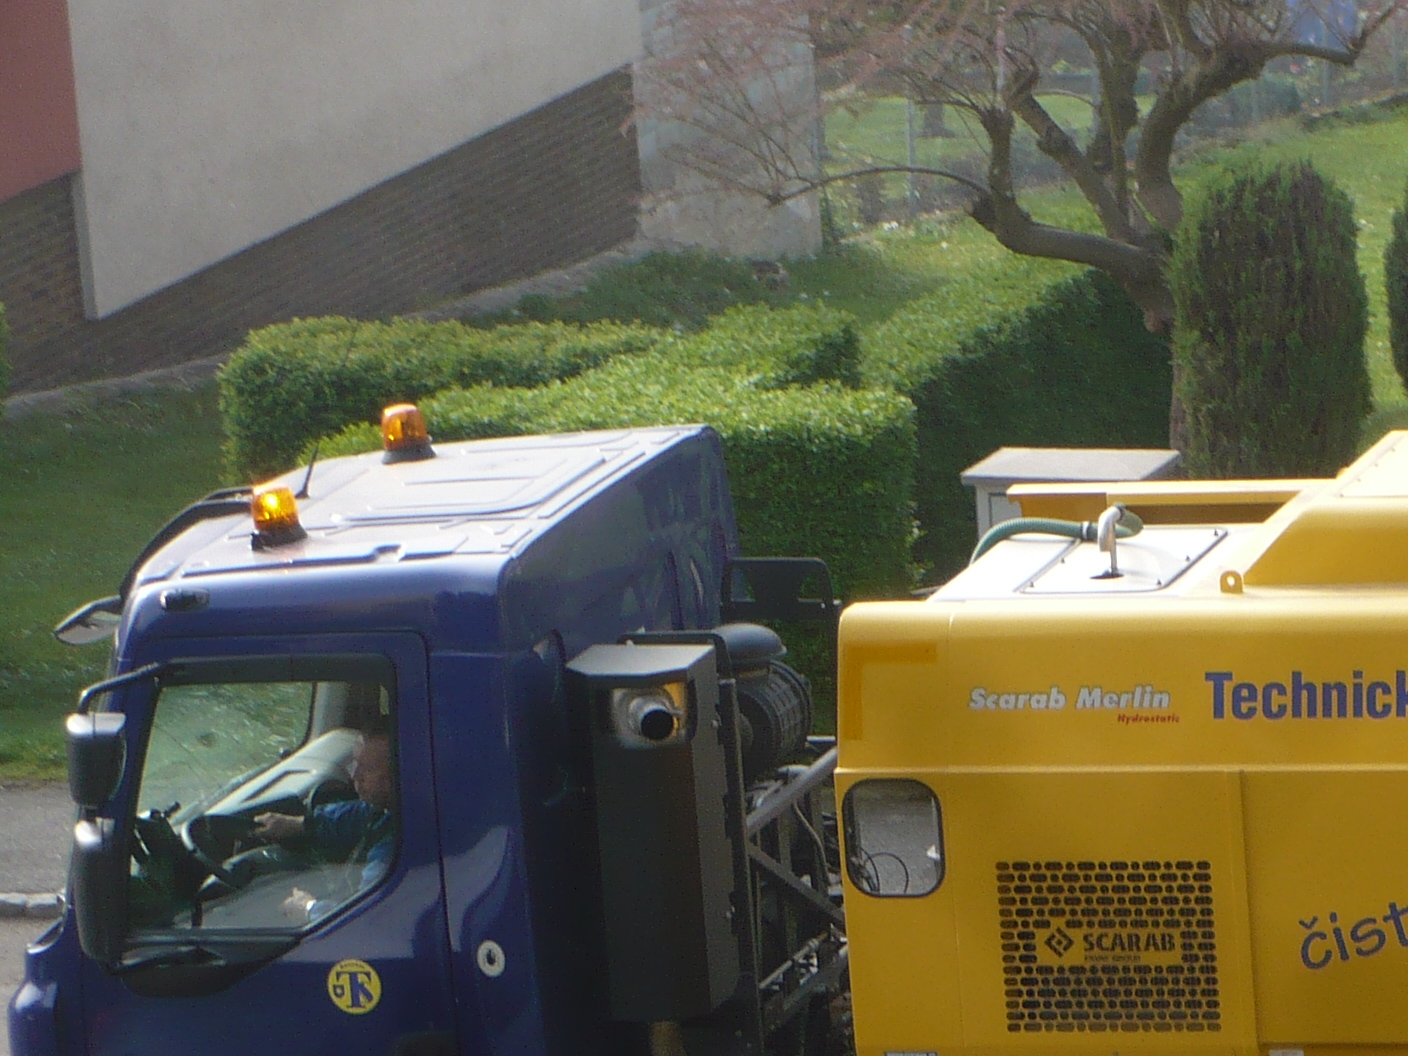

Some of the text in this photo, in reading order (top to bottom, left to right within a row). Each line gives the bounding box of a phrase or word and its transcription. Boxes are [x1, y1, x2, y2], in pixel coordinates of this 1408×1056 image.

[969, 685, 1170, 710] Scarab Merlin
[1083, 933, 1175, 951] SCARAB
